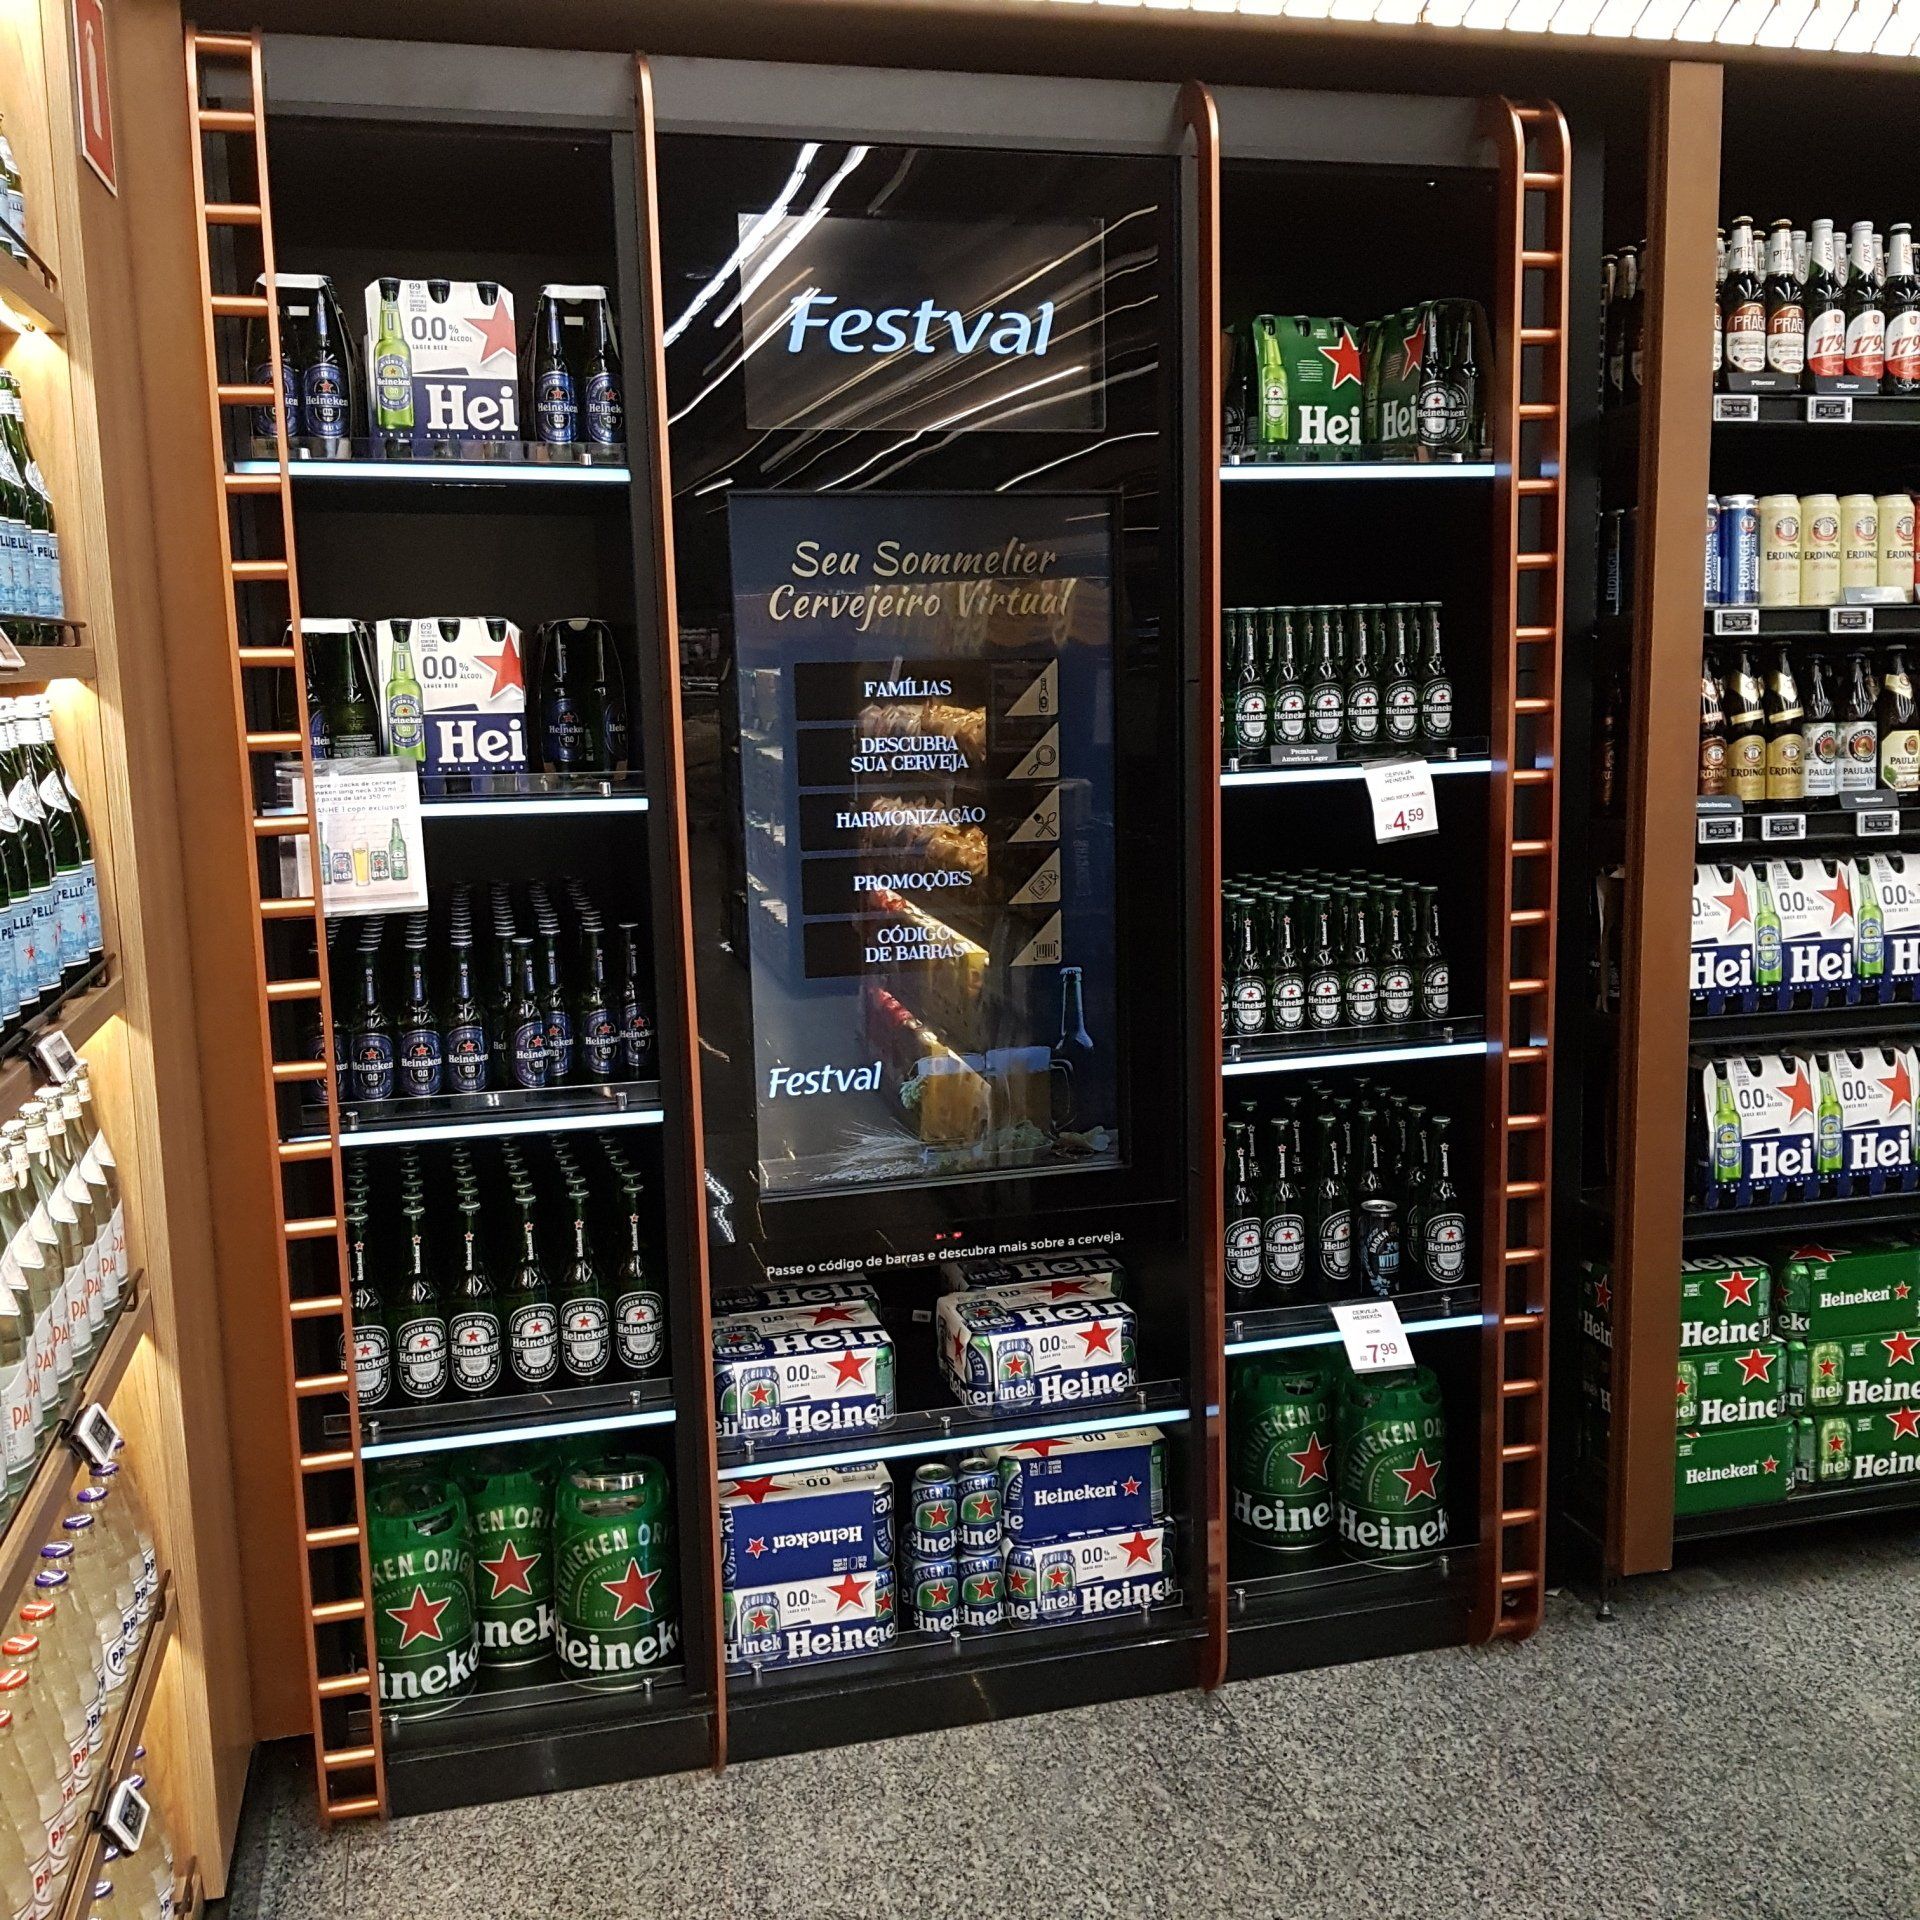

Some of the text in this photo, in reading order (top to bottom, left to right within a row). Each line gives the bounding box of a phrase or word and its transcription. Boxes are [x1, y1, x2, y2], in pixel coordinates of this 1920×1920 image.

[787, 296, 1054, 356] Festval
[425, 384, 519, 431] Hei
[1298, 406, 1361, 445] Hei
[791, 537, 1056, 578] Seu Sommelier
[1738, 533, 1751, 591] ERDINGER
[769, 578, 1077, 632] Cervejeiro Virtual
[864, 677, 952, 698] FAMÍLIAS
[436, 718, 526, 764] Hei
[860, 735, 959, 754] DESCUBRA
[850, 753, 970, 773] SUA CERVEJA
[836, 805, 986, 828] HARMONIZAÇÃO
[853, 869, 973, 892] PROMOÇÕES
[877, 925, 952, 945] CÓDIGO
[865, 944, 965, 963] DE BARRAS
[1790, 942, 1853, 983] Hei
[768, 1060, 882, 1098] Festval
[1750, 1138, 1813, 1179] Hei
[1851, 1129, 1911, 1169] Hei
[766, 1230, 1125, 1277] Passe o código de barras e descubra mais sobre a cerveja.
[1369, 1230, 1389, 1254] BADEN
[1820, 1287, 1890, 1309] Heineken
[1015, 1301, 1134, 1326] Hein
[512, 1333, 558, 1348] Heineken
[562, 1327, 609, 1342] Heineken
[771, 1329, 892, 1354] Hein
[399, 1347, 447, 1363] Heineken
[451, 1341, 499, 1357] Heineken
[968, 1350, 985, 1377] BEER
[1686, 1464, 1758, 1485] Heineken
[1034, 1484, 1117, 1506] Heineken
